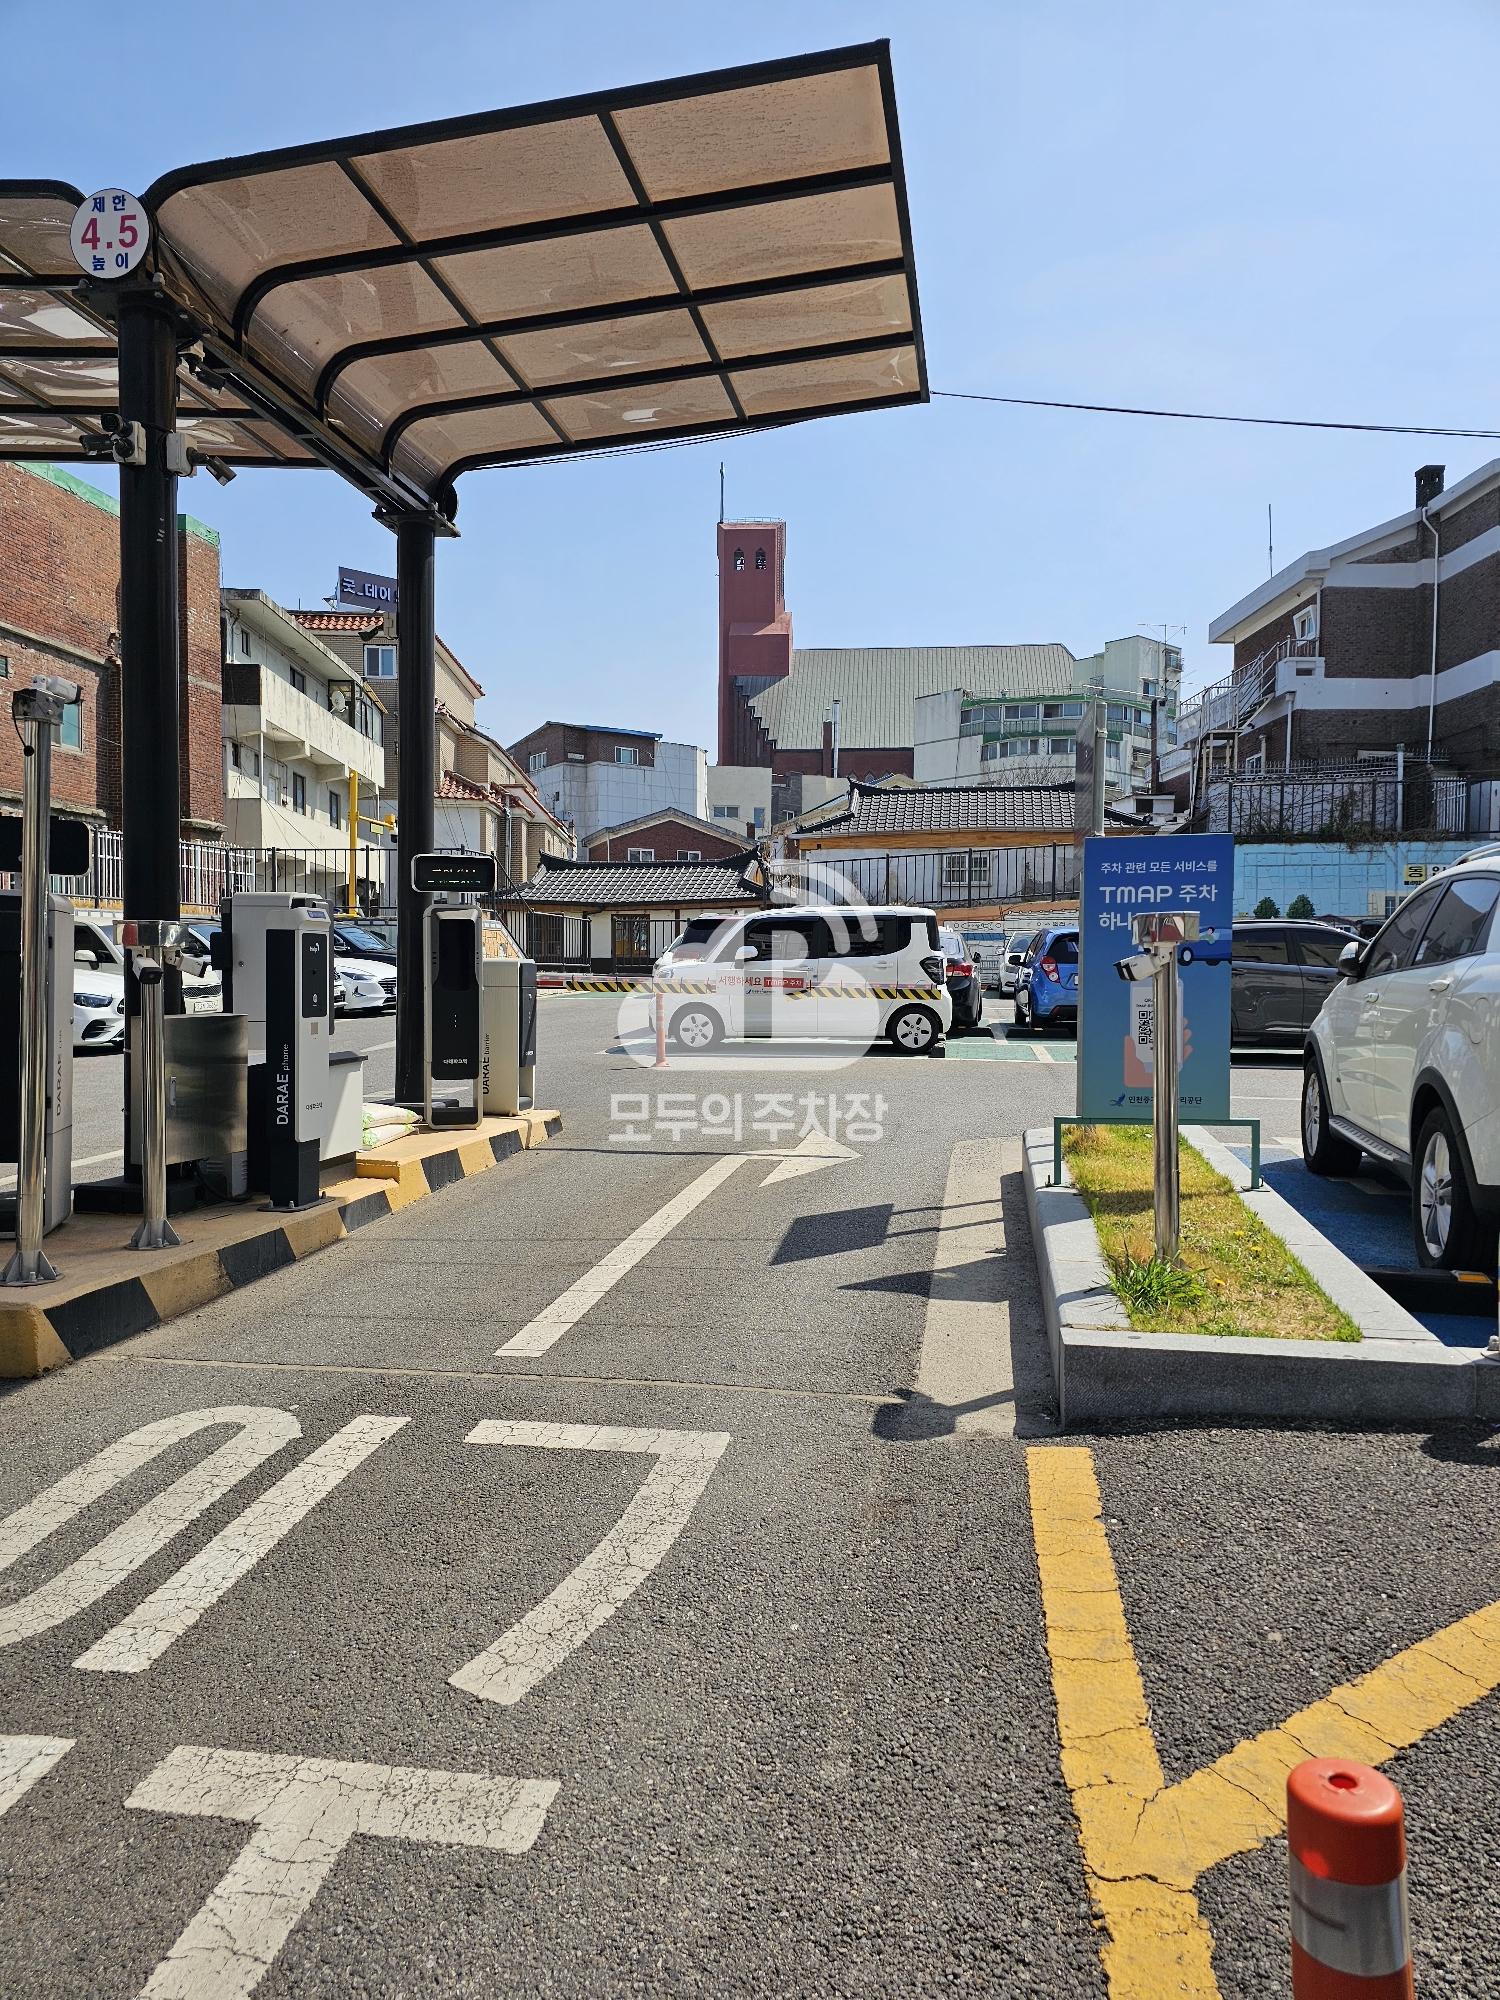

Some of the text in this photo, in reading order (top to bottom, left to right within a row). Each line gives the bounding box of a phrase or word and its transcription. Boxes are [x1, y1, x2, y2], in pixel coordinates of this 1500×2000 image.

[92, 195, 127, 212] 제한
[81, 214, 138, 250] 4.5
[92, 253, 129, 271] 높이
[1100, 860, 1218, 874] 주차 관련 모든 서비스를
[1099, 884, 1218, 903] TMAP 주차
[719, 976, 762, 986] 서행하세요
[276, 1043, 291, 1125] DARAE phone
